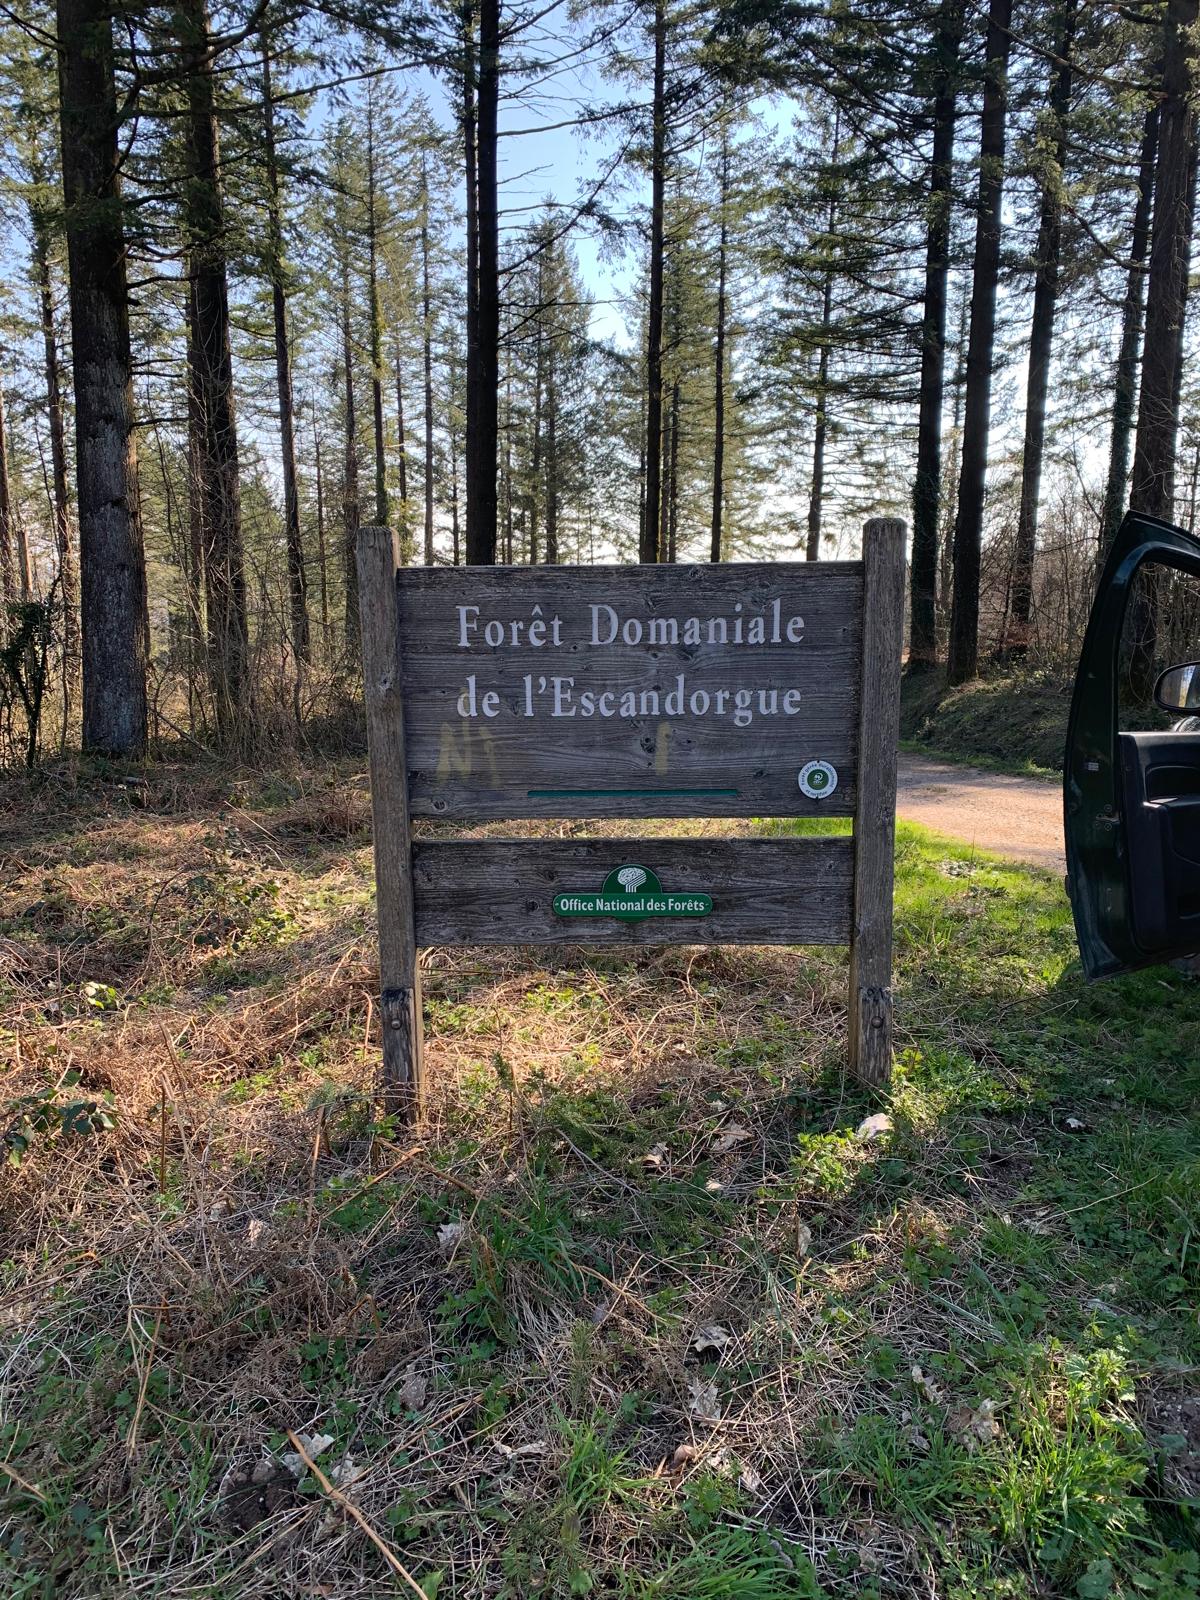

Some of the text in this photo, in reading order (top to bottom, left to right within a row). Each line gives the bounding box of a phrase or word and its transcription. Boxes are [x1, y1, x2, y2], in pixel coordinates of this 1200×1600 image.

[456, 598, 805, 648] Forêt Domaniale
[457, 673, 802, 727] de l'Escandorgue
[560, 898, 705, 911] Office National des Forêts
